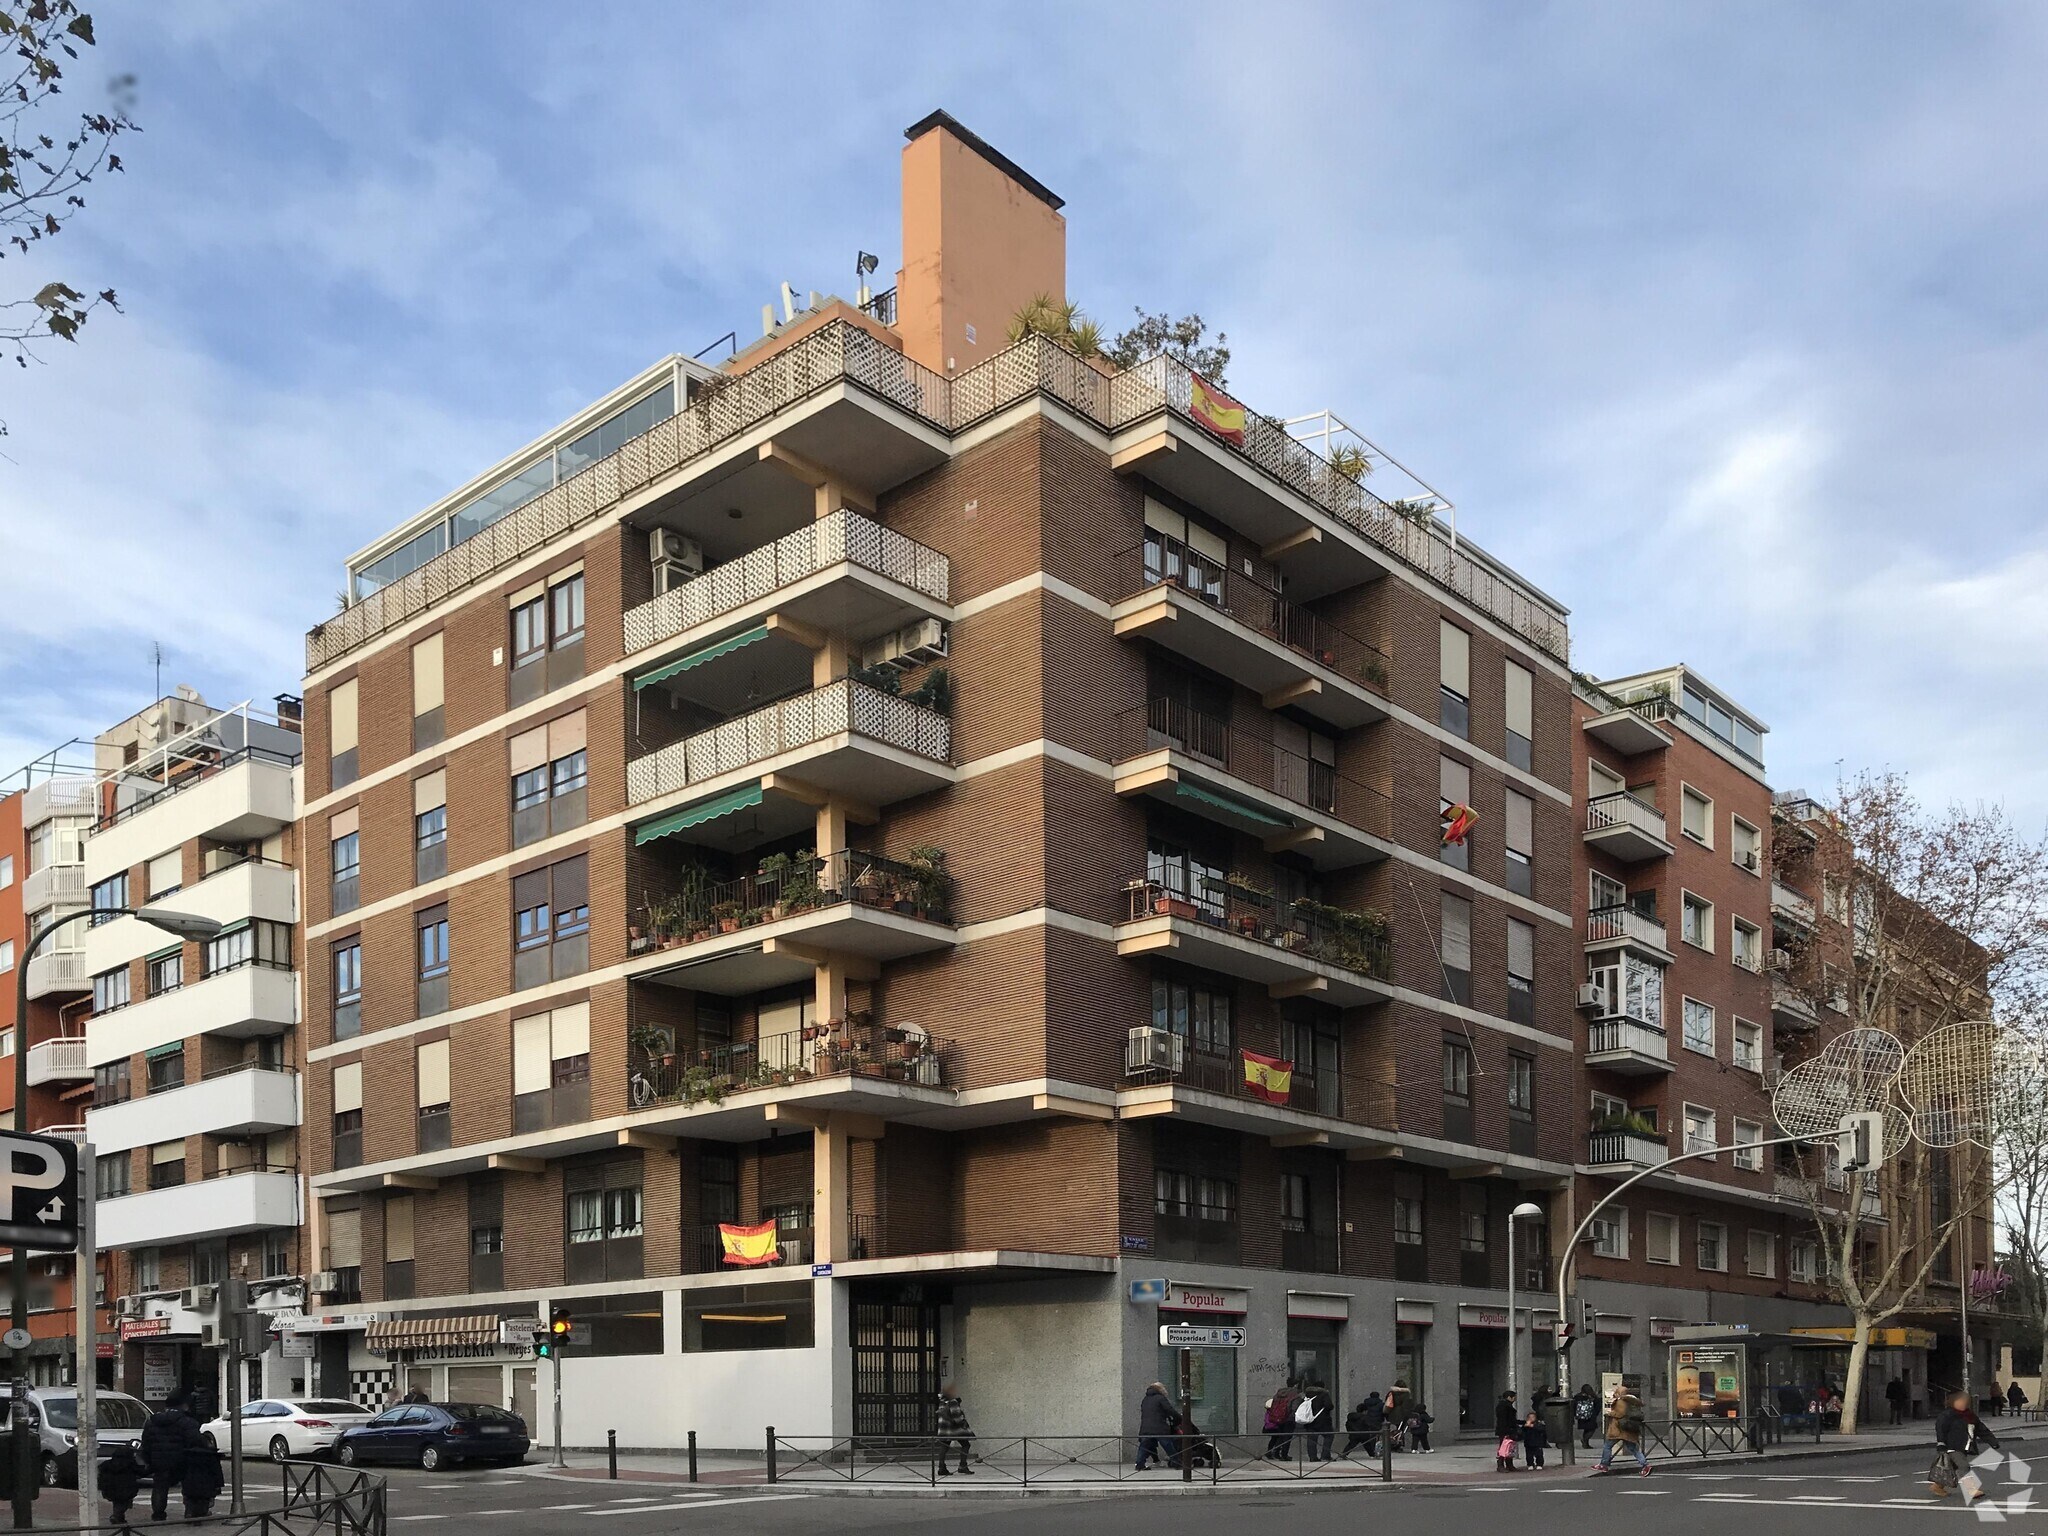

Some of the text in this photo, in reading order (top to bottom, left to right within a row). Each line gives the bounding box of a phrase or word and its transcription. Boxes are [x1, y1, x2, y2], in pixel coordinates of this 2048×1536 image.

[0, 1136, 66, 1220] P
[1182, 1292, 1226, 1307] Popular
[1479, 1312, 1507, 1324] Popular
[125, 1320, 159, 1331] MATERIALES
[1656, 1323, 1674, 1334] Popula
[1169, 1334, 1206, 1342] Prosperidad
[508, 1343, 531, 1359] Reyes
